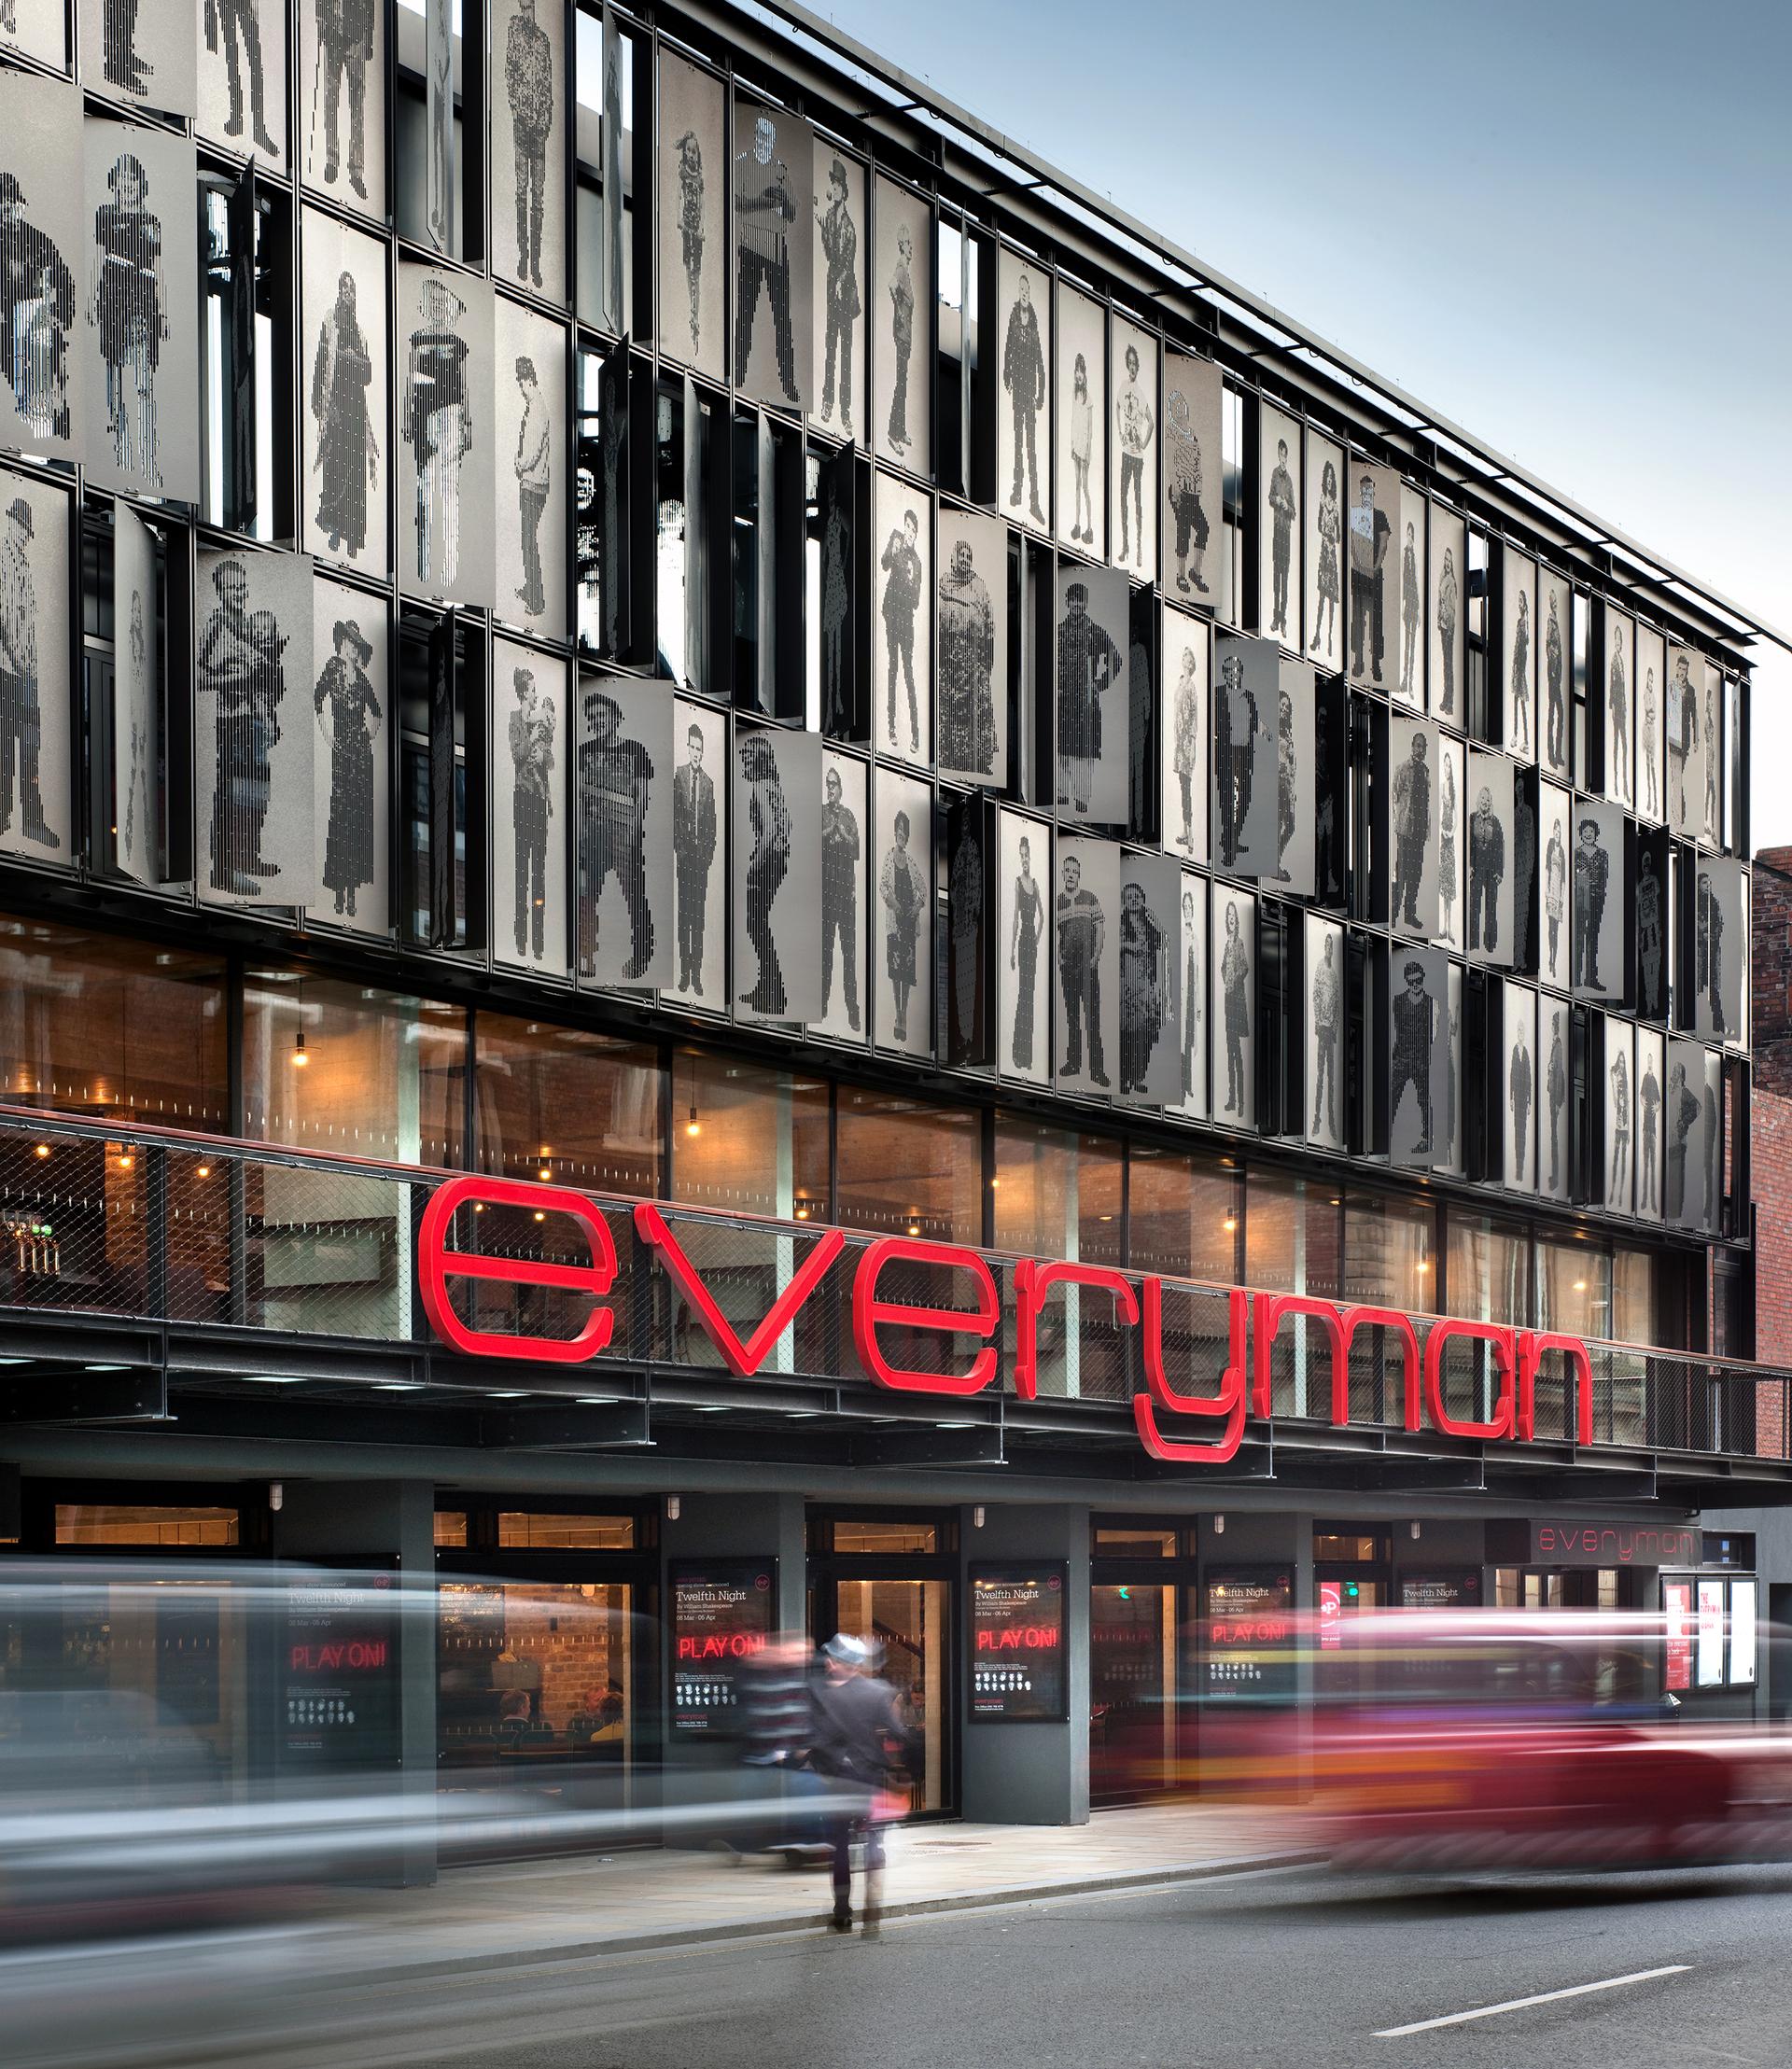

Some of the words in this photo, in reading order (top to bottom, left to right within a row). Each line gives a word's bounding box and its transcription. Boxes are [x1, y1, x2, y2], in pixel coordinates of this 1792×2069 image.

[419, 1175, 1594, 1463] everyman
[1539, 1528, 1693, 1561] everyman
[334, 1589, 365, 1605] Night
[676, 1590, 716, 1601] Twelfth
[718, 1590, 747, 1602] Night
[974, 1589, 1011, 1600] Twelfth
[1013, 1589, 1040, 1601] Night
[1246, 1588, 1269, 1599] Night
[1403, 1588, 1435, 1597] Twelfth
[1436, 1588, 1459, 1598] Night
[978, 1629, 1023, 1651] PLAY
[1025, 1627, 1057, 1648] ON!
[1212, 1624, 1255, 1643] PLAY
[1256, 1623, 1286, 1642] ON!
[291, 1644, 344, 1670] PLAY
[349, 1642, 387, 1668] ON!
[679, 1636, 728, 1659] PLAY
